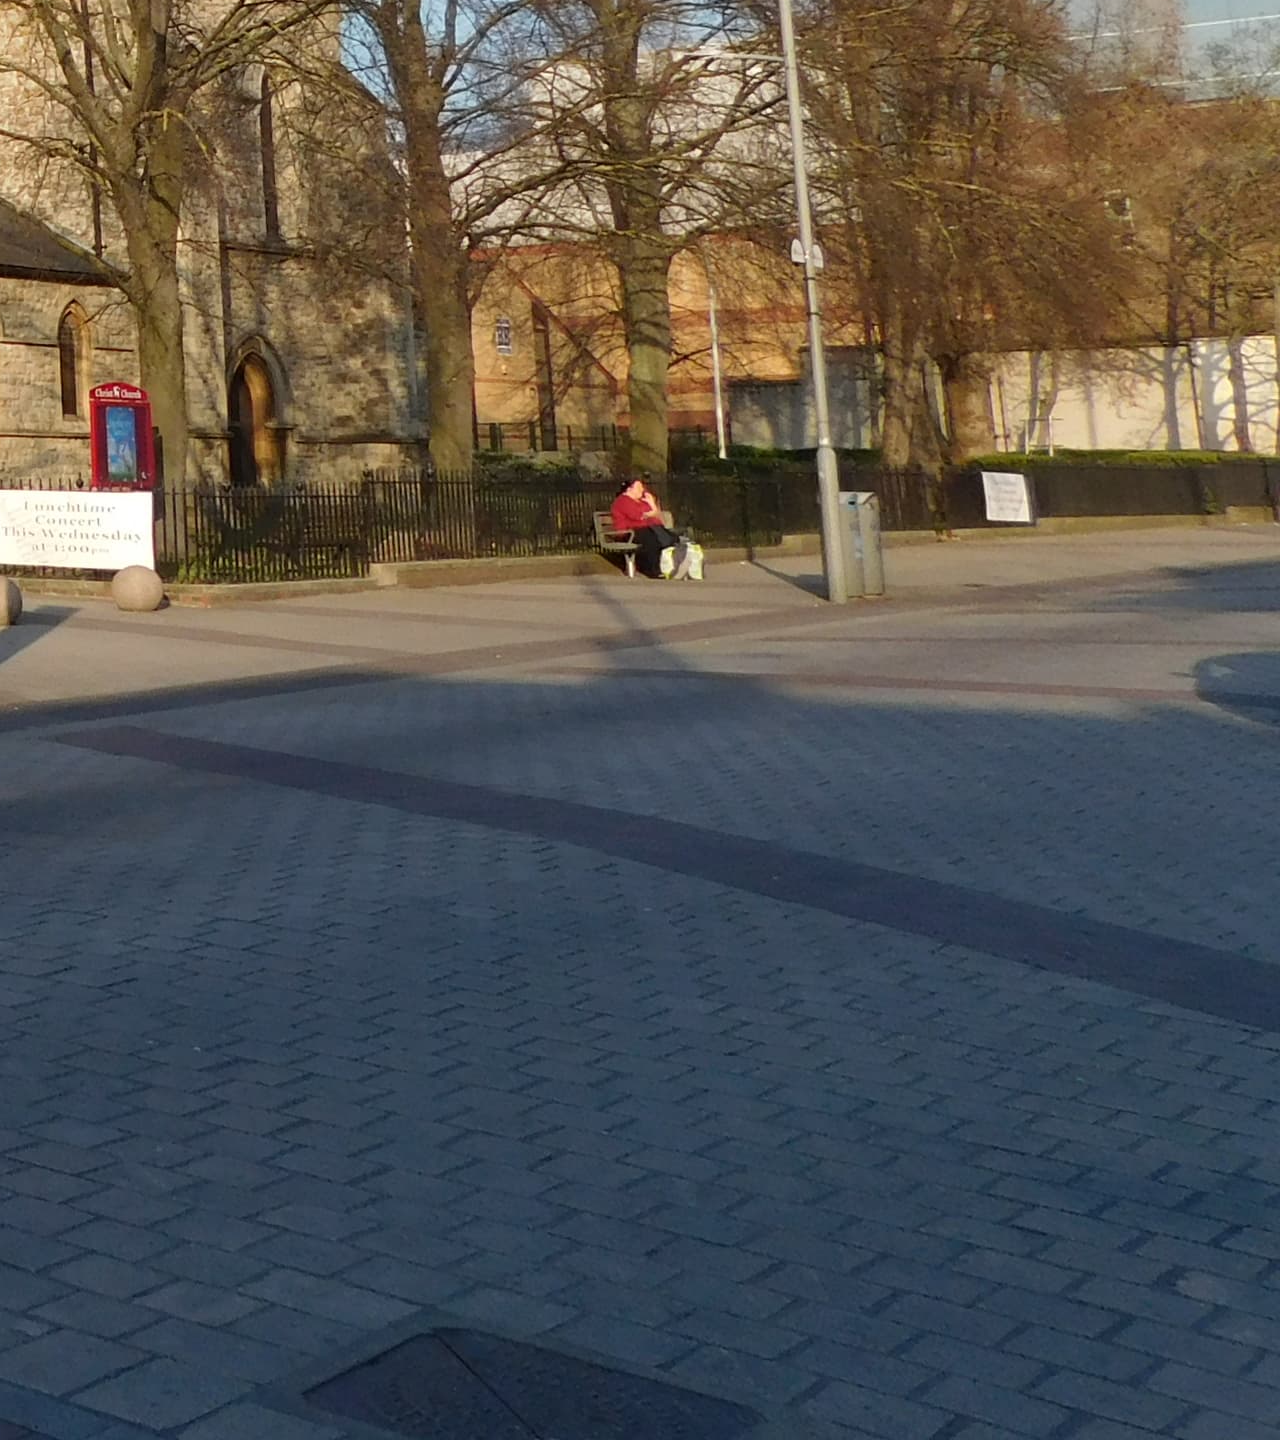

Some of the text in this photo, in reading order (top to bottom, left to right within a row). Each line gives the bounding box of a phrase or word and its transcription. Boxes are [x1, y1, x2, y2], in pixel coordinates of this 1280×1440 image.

[95, 388, 141, 399] Christ Church
[34, 515, 103, 527] Concert
[2, 526, 142, 544] This Wednesday
